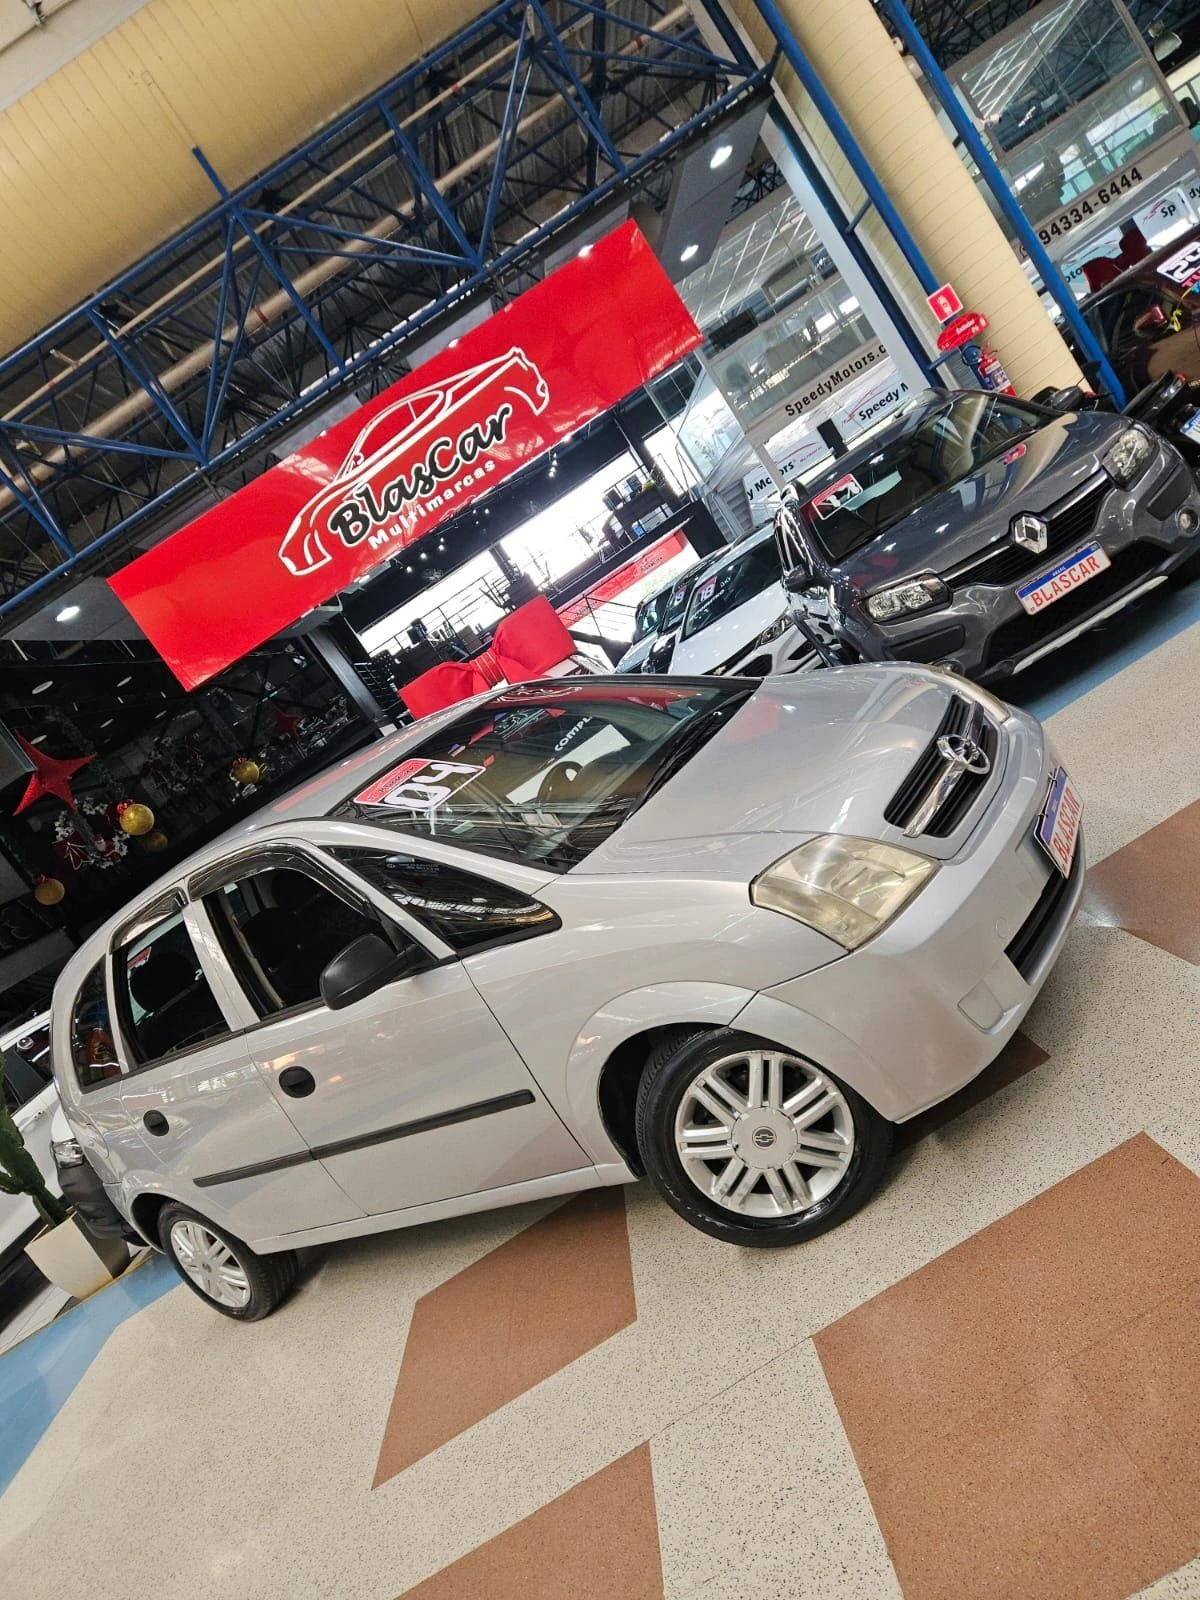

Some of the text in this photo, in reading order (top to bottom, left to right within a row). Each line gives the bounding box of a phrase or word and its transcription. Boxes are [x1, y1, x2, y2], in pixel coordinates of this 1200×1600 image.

[1038, 167, 1143, 245] 94334-6444
[858, 387, 899, 421] Speedy
[328, 403, 512, 547] BlasCar
[368, 460, 496, 549] Multimarcas
[1030, 555, 1100, 608] BLASCAR
[383, 763, 480, 808] 04
[1053, 786, 1080, 864] BLASCAR
